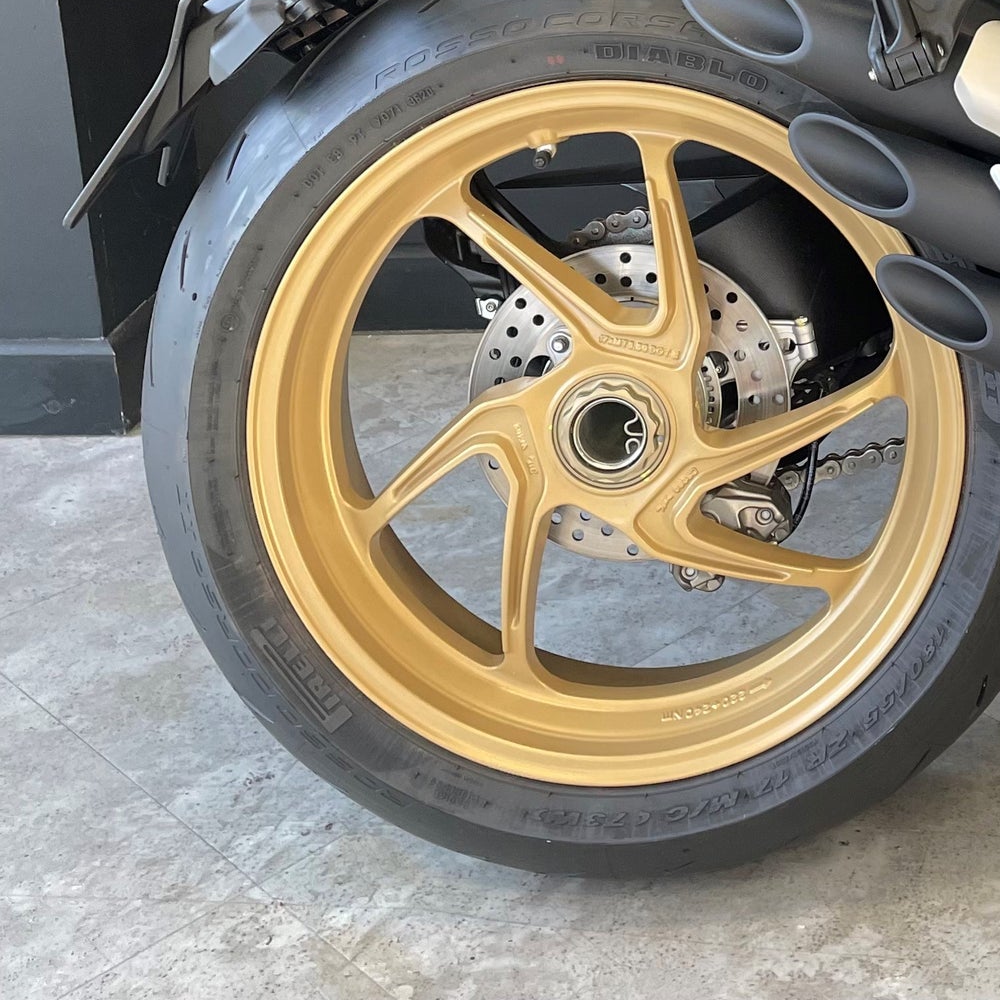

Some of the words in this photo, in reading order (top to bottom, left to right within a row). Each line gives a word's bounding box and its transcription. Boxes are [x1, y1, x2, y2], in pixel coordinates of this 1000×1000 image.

[374, 17, 533, 90] ROSSO
[593, 42, 768, 93] DIABLO
[249, 614, 355, 735] PIRELLI
[805, 730, 850, 772] ZR
[665, 789, 740, 823] M/C
[753, 770, 793, 799] 17
